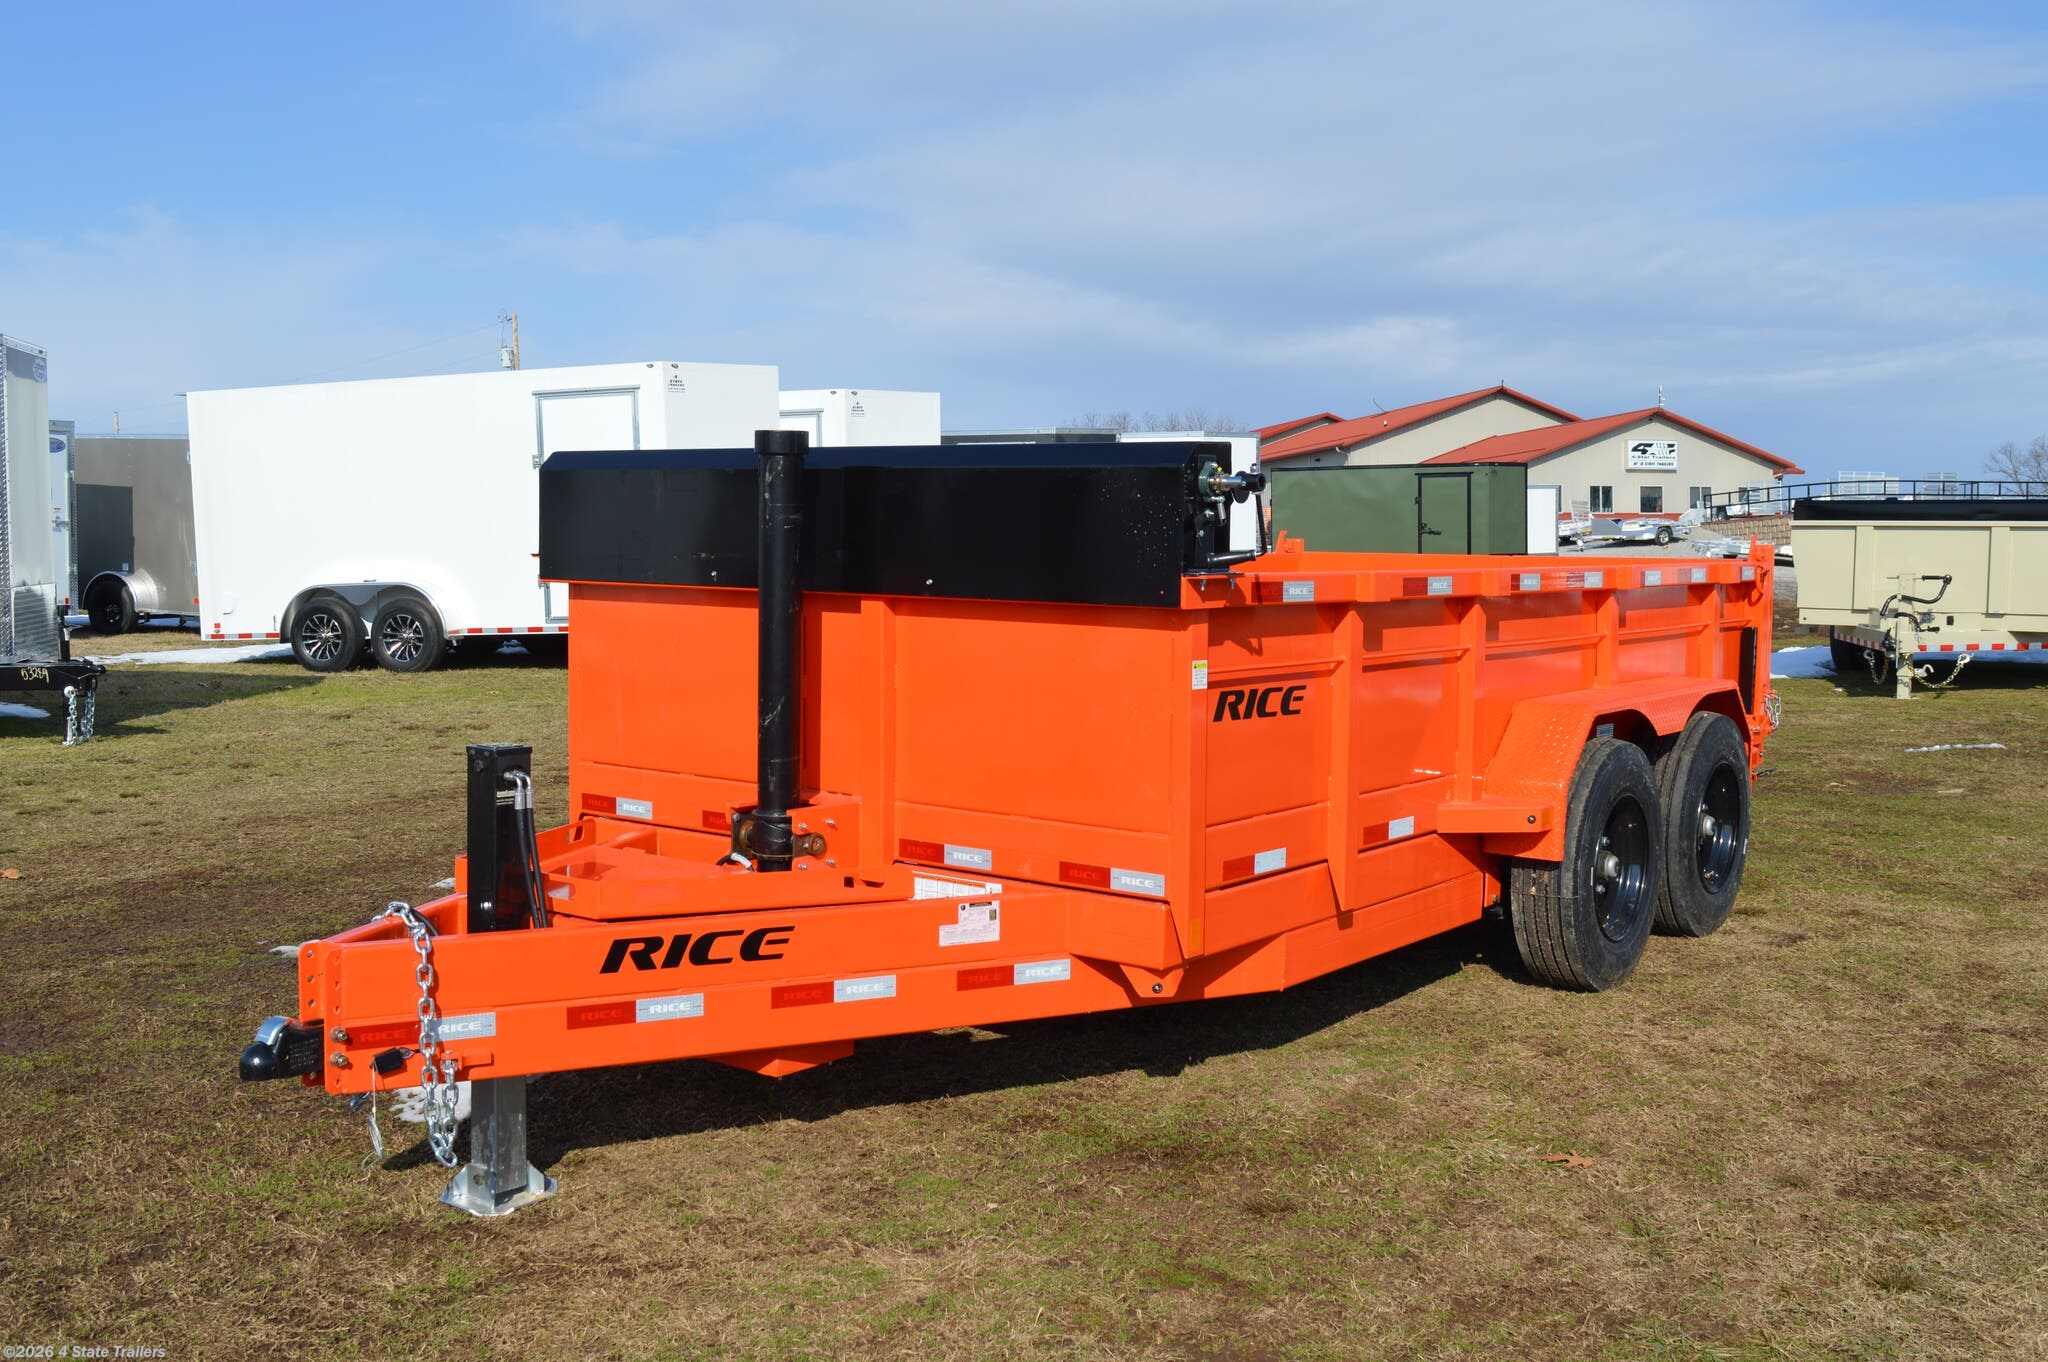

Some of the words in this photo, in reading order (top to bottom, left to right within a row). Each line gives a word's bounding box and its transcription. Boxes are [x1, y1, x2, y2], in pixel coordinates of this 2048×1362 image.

[1212, 685, 1307, 722] RICE
[623, 803, 645, 813] RICE
[952, 851, 984, 863] RICE
[1121, 876, 1154, 888] RICE
[600, 926, 795, 974] RICE
[1025, 966, 1062, 977] RICE
[846, 983, 885, 994] RICE
[650, 1001, 691, 1014] RICE
[438, 1020, 481, 1034] RICE
